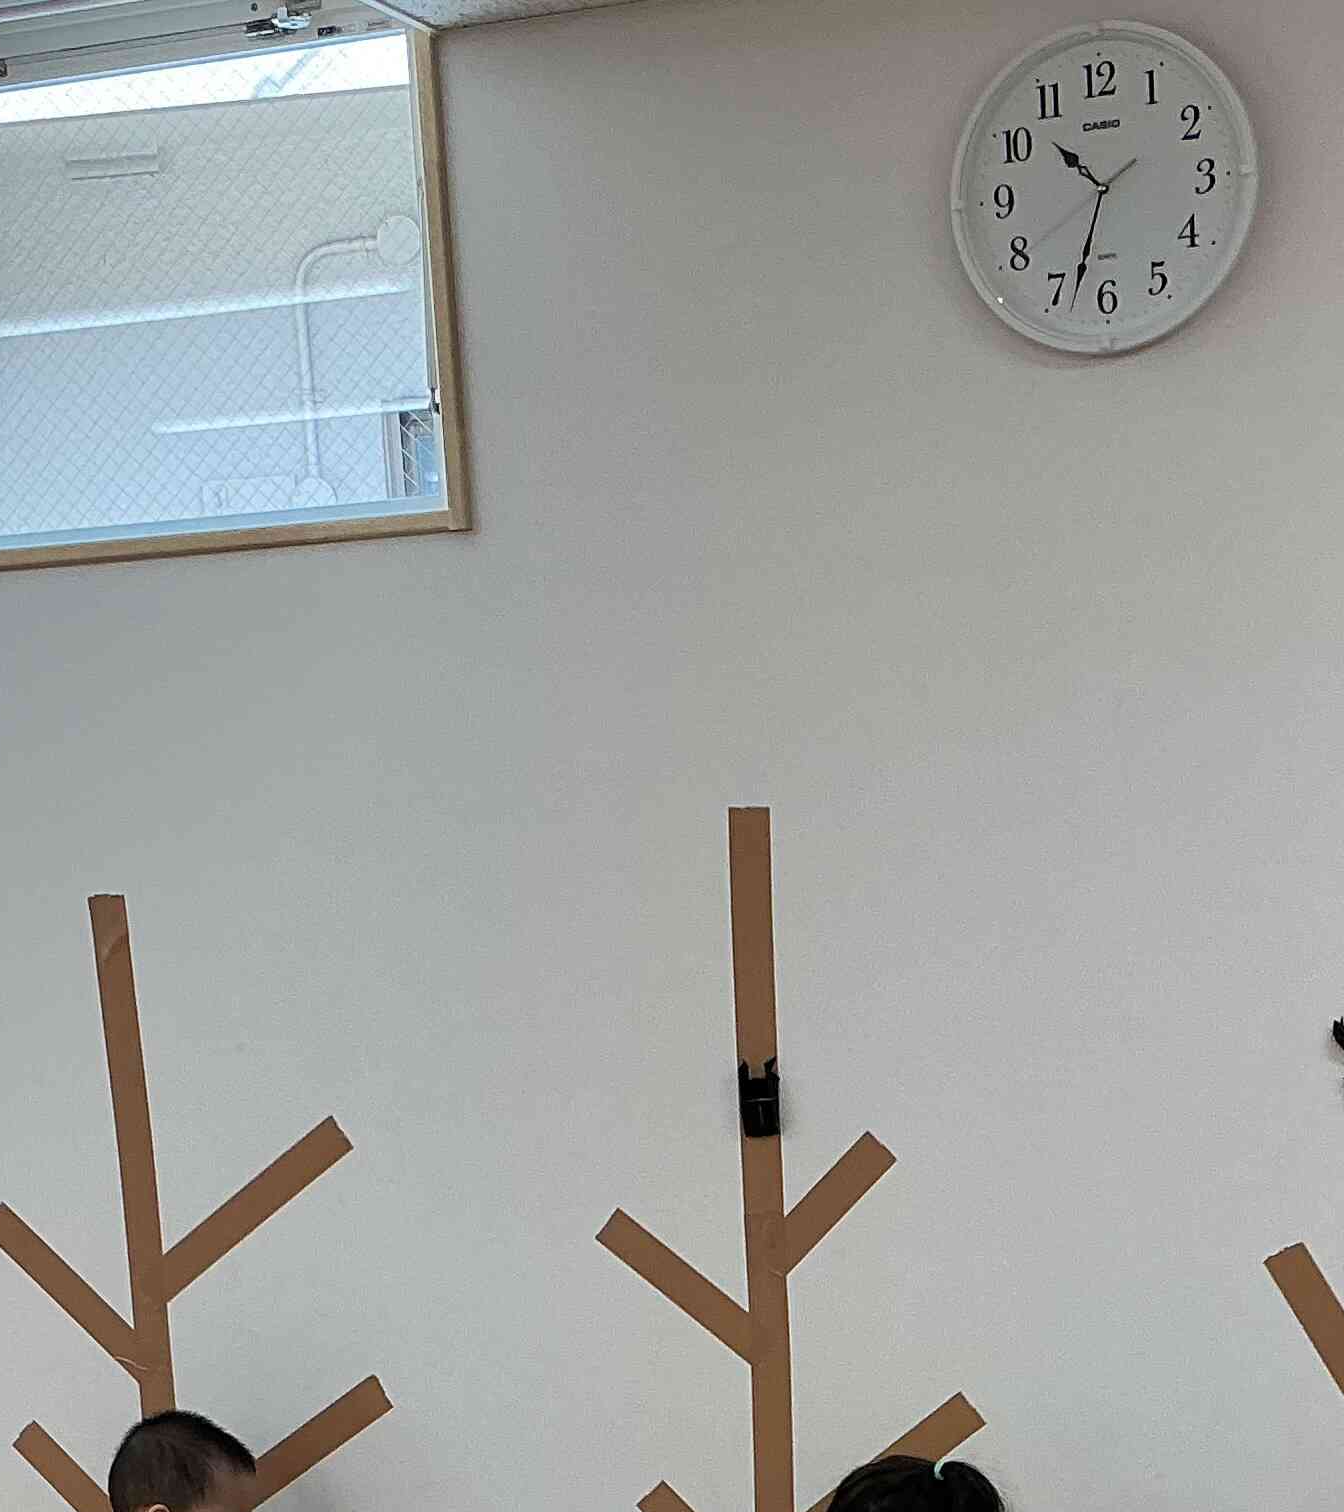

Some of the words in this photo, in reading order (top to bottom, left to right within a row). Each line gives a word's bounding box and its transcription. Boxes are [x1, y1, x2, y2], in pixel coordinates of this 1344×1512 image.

[1082, 61, 1117, 99] 12
[1143, 69, 1158, 105] 1
[1035, 82, 1062, 120] 11
[1082, 119, 1121, 132] CASIO
[1180, 104, 1202, 141] 2
[1001, 127, 1033, 164] 10
[1194, 158, 1216, 195] 3
[993, 184, 1015, 219] 9
[1177, 213, 1200, 249] 4
[1009, 235, 1030, 271] 8
[1047, 272, 1066, 306] 7
[1147, 260, 1168, 296] 5
[1096, 279, 1118, 314] 6
